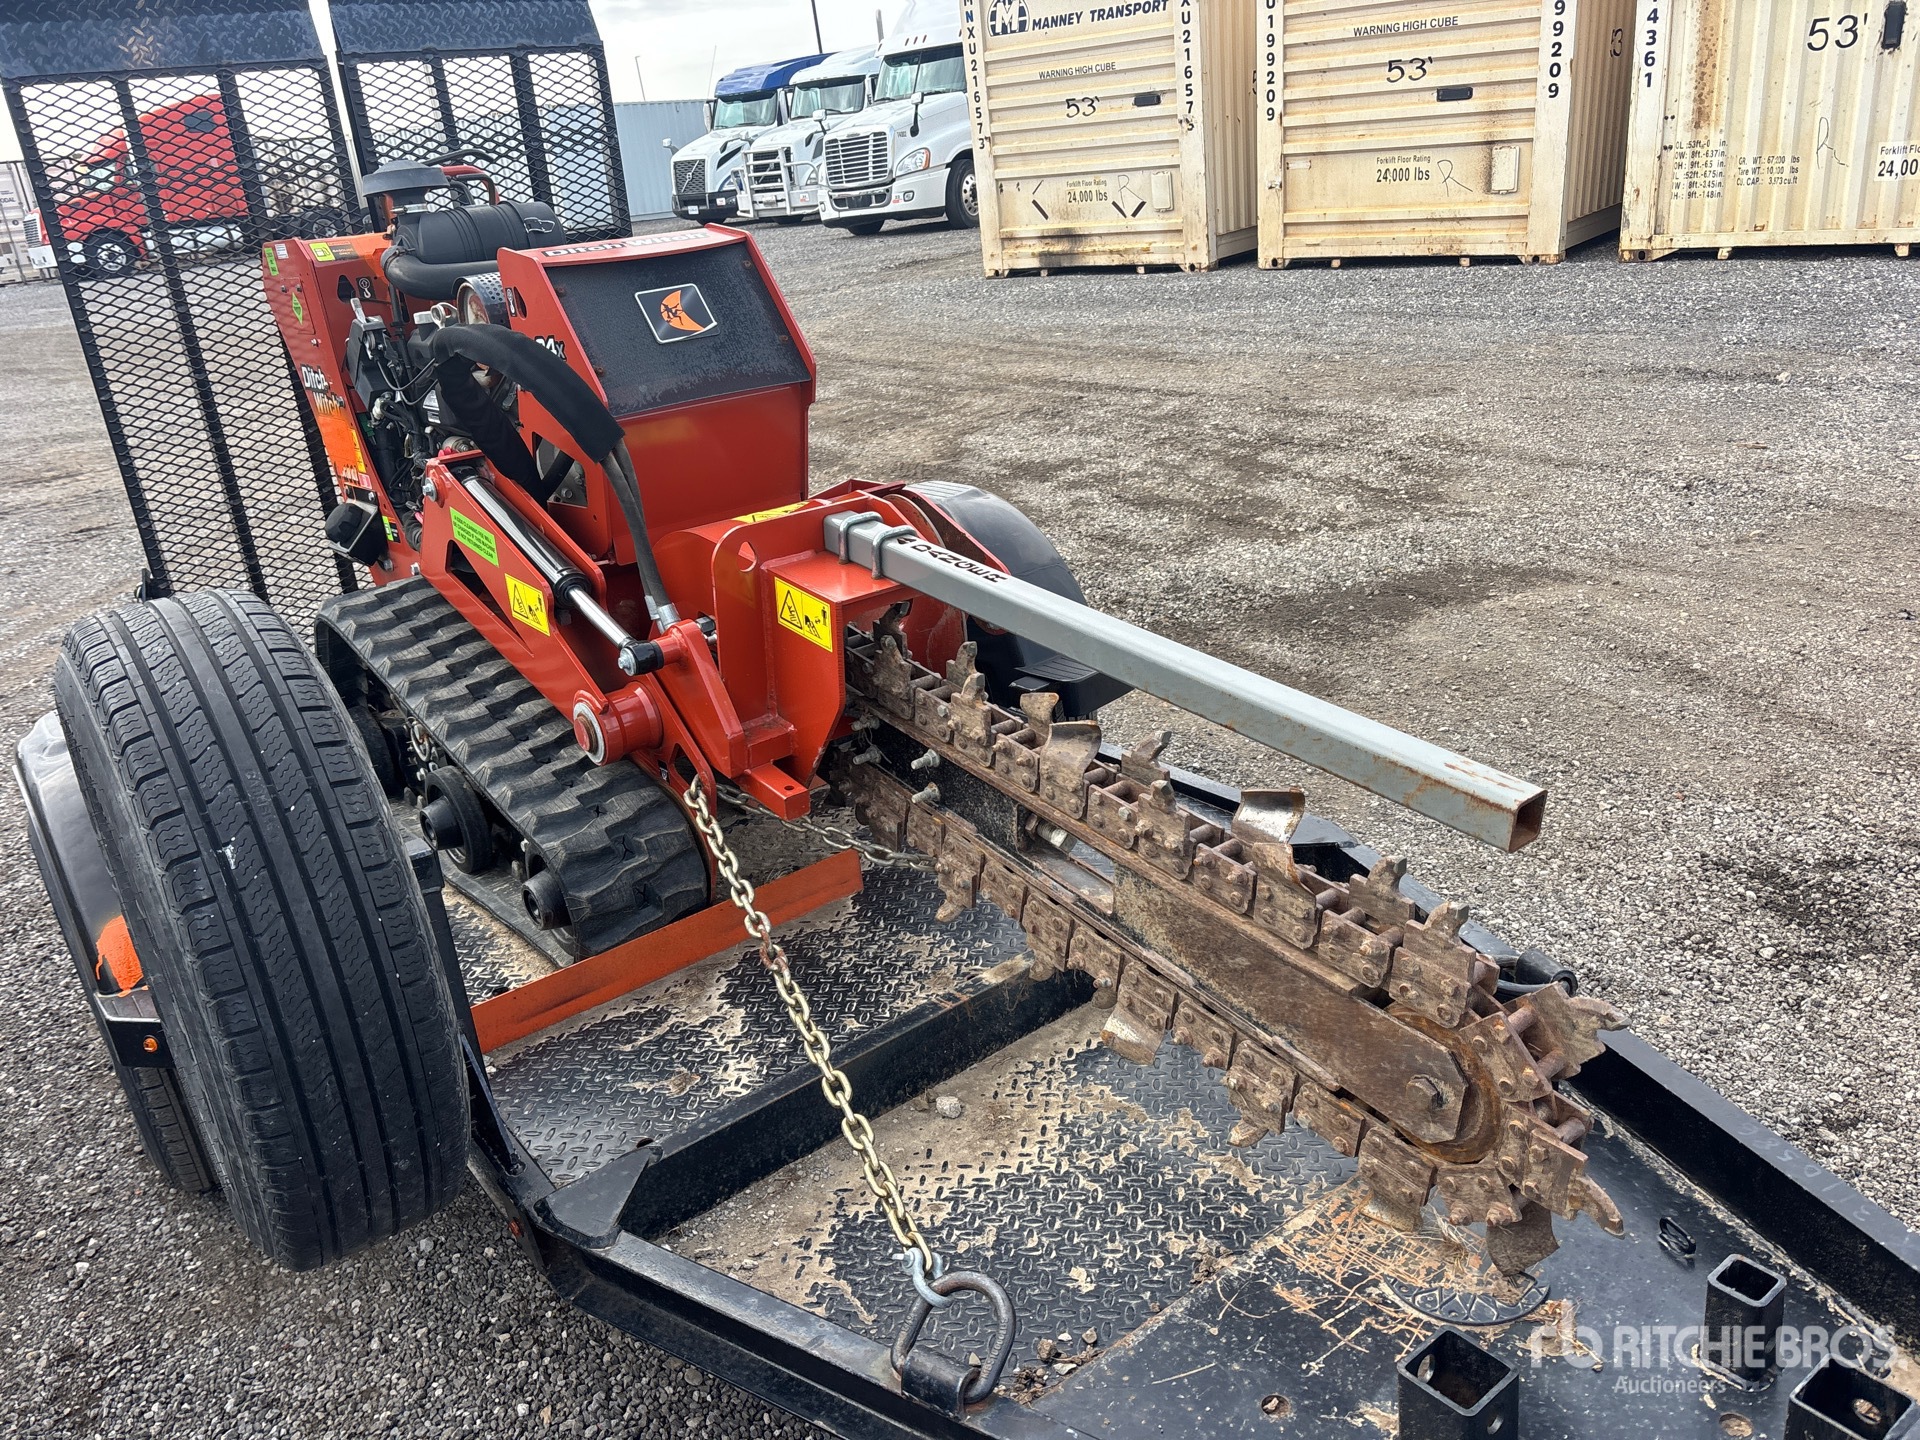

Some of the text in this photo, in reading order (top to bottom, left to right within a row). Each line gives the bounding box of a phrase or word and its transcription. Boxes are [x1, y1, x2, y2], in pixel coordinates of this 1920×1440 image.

[1031, 0, 1169, 31] MANNEY TRANSPORT
[1353, 16, 1459, 37] WARNING HIGH CUBE
[1806, 13, 1869, 51] 53'
[1038, 62, 1117, 80] WARNING HIGH CUBE
[1386, 56, 1434, 83] 53'
[1065, 95, 1100, 118] 53'
[1790, 154, 1800, 164] lbs
[1880, 145, 1908, 155] Forklift
[1376, 155, 1431, 165] Forklift Floor Rating
[1376, 167, 1430, 184] 24,000 lbs
[1789, 165, 1799, 174] lbs
[1066, 180, 1081, 188] Forklift
[1067, 189, 1108, 204] 24,000 lbs
[301, 365, 326, 390] Ditch
[910, 544, 1008, 583] DANGER
